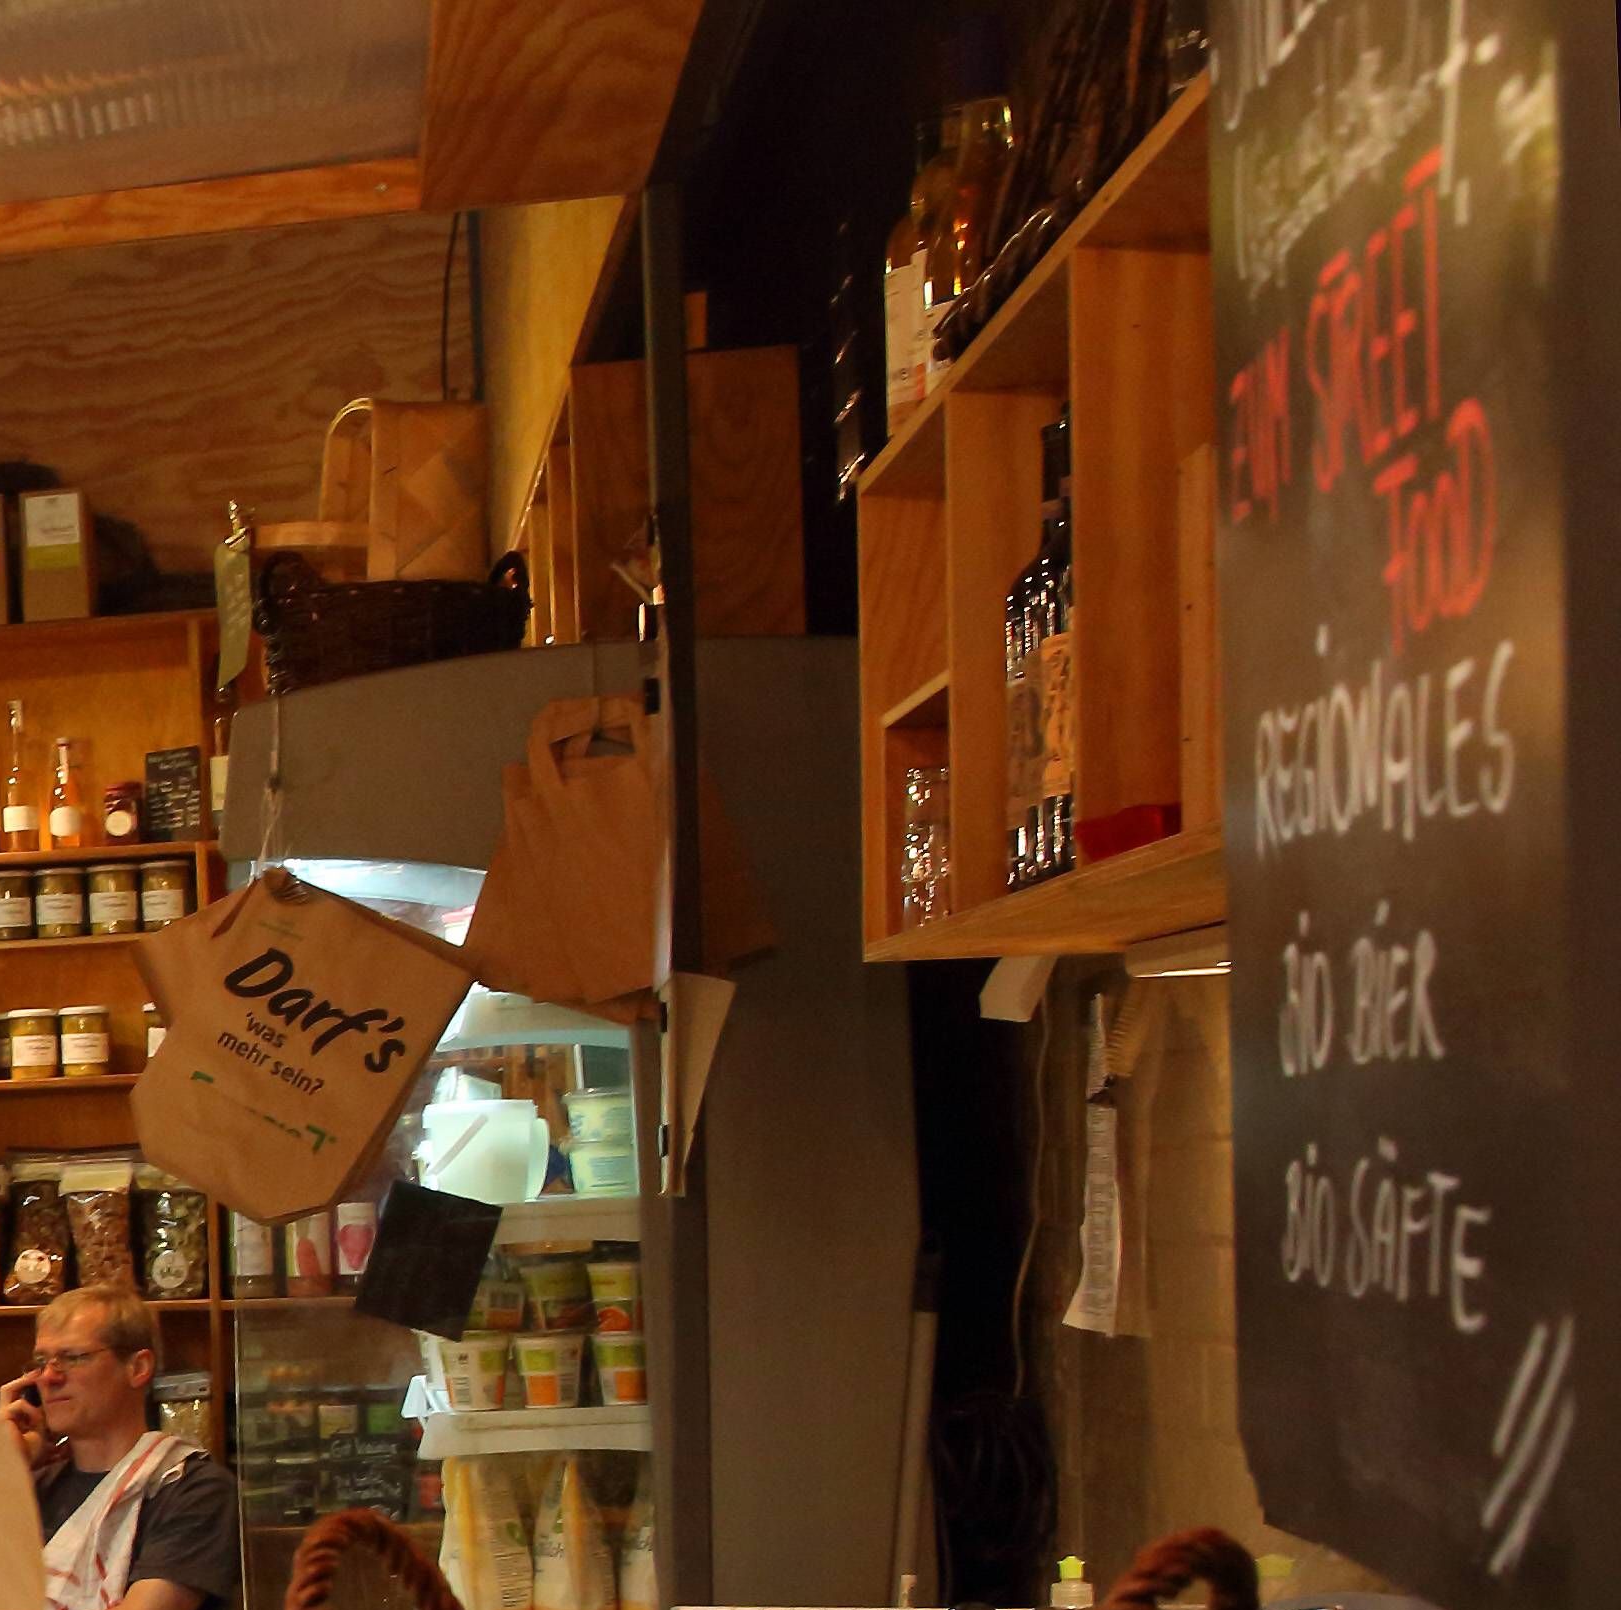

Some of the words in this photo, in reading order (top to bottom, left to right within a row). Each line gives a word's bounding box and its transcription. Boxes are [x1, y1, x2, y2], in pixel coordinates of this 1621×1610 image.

[1373, 398, 1496, 655] FOOD
[1254, 632, 1517, 862] REGIONALES
[217, 1032, 271, 1067] mehr
[270, 1060, 325, 1096] sein?
[224, 947, 405, 1073] Darf's
[1349, 900, 1447, 1066] BIER
[1281, 1142, 1336, 1288] BIO
[1349, 1134, 1493, 1334] SÄFTE
